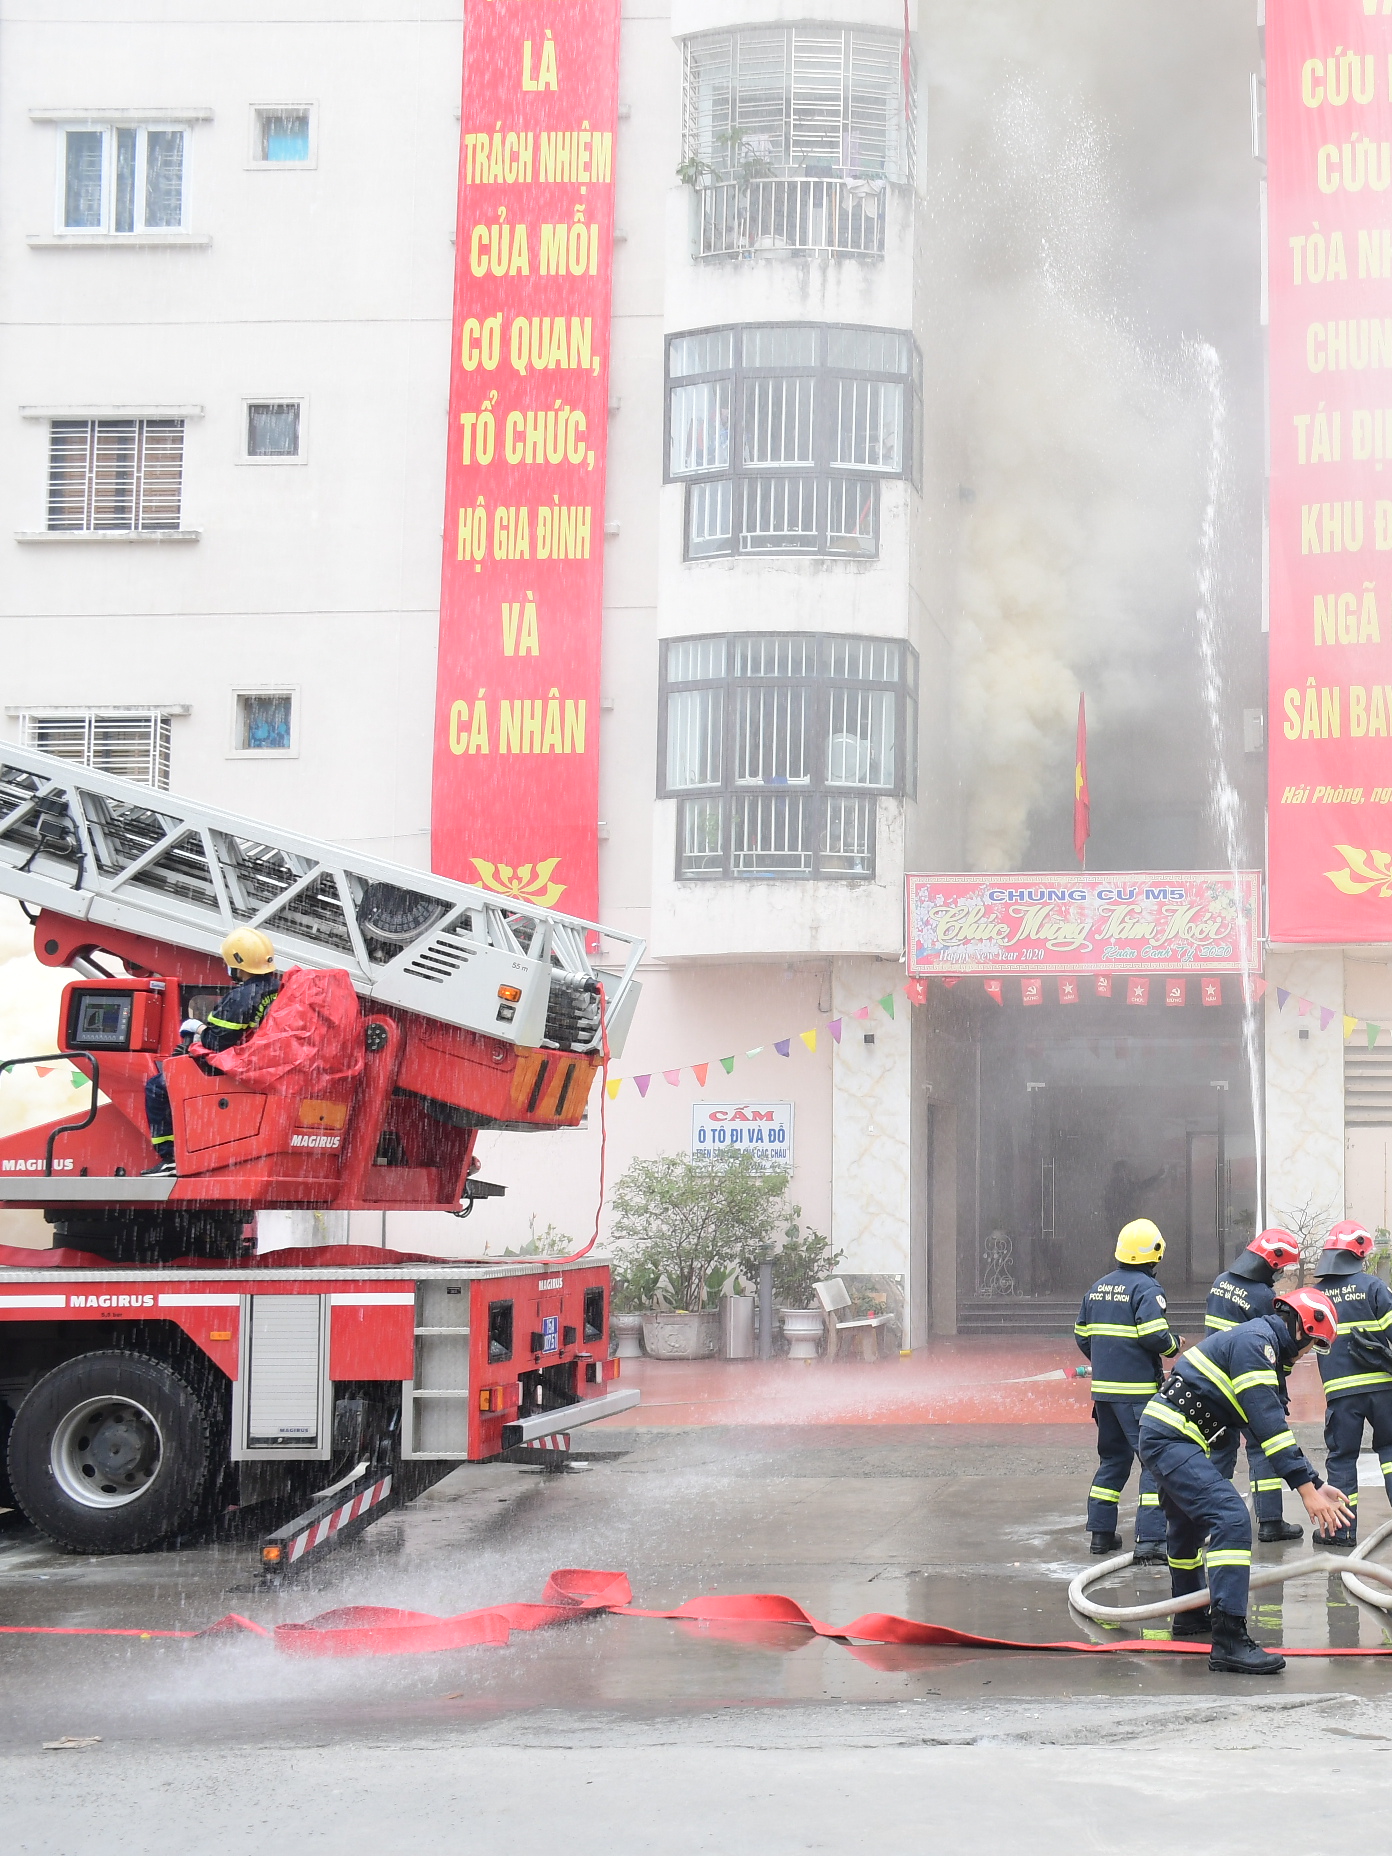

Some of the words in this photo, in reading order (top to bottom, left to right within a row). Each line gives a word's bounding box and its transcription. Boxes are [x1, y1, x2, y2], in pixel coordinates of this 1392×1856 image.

[522, 30, 557, 91] LÀ
[1301, 46, 1375, 108] CỨU
[465, 122, 534, 184] TRÁCH
[539, 121, 612, 194] NHIỆM
[1317, 132, 1390, 194] CỨU
[470, 207, 529, 277] CỦA
[539, 205, 598, 276] MỖI
[1289, 221, 1348, 285] TÒA
[461, 312, 503, 371] CƠ
[510, 316, 600, 376] QUAN,
[460, 390, 498, 465] TỔ
[505, 400, 595, 470] CHỨC,
[1294, 401, 1341, 464] TÁI
[457, 496, 487, 572] HỘ
[493, 507, 529, 561] GIA
[536, 495, 591, 560] ĐÌNH
[1301, 500, 1363, 555] KHU
[502, 591, 540, 656] VÀ
[1313, 581, 1380, 646] NGÃ
[449, 688, 489, 755] CÁ
[499, 688, 586, 754] NHÂN
[1283, 676, 1341, 740] SÂN
[1280, 783, 1311, 804] Hải
[1311, 784, 1366, 805] Phòng,
[988, 888, 1087, 902] CHUNG
[1096, 887, 1138, 901] CƯ
[1144, 887, 1186, 901] M5
[929, 904, 1010, 947] Chúc
[1001, 904, 1093, 952] Mừng
[1095, 904, 1157, 940] Năm
[1149, 904, 1232, 947] Mới
[1020, 948, 1045, 960] 2020
[1199, 945, 1233, 957] 2020
[290, 1134, 340, 1148] MAGIRUS
[698, 1125, 706, 1143] Ô
[711, 1125, 726, 1143] TÔ
[730, 1128, 743, 1143] ĐI
[748, 1125, 764, 1143] VÀ
[708, 1105, 775, 1121] CẤM
[70, 1294, 154, 1307] MAGIRUS
[538, 1277, 563, 1291] MAGIRUS
[1341, 1284, 1357, 1294] SÁT
[1344, 1292, 1366, 1301] CNCH
